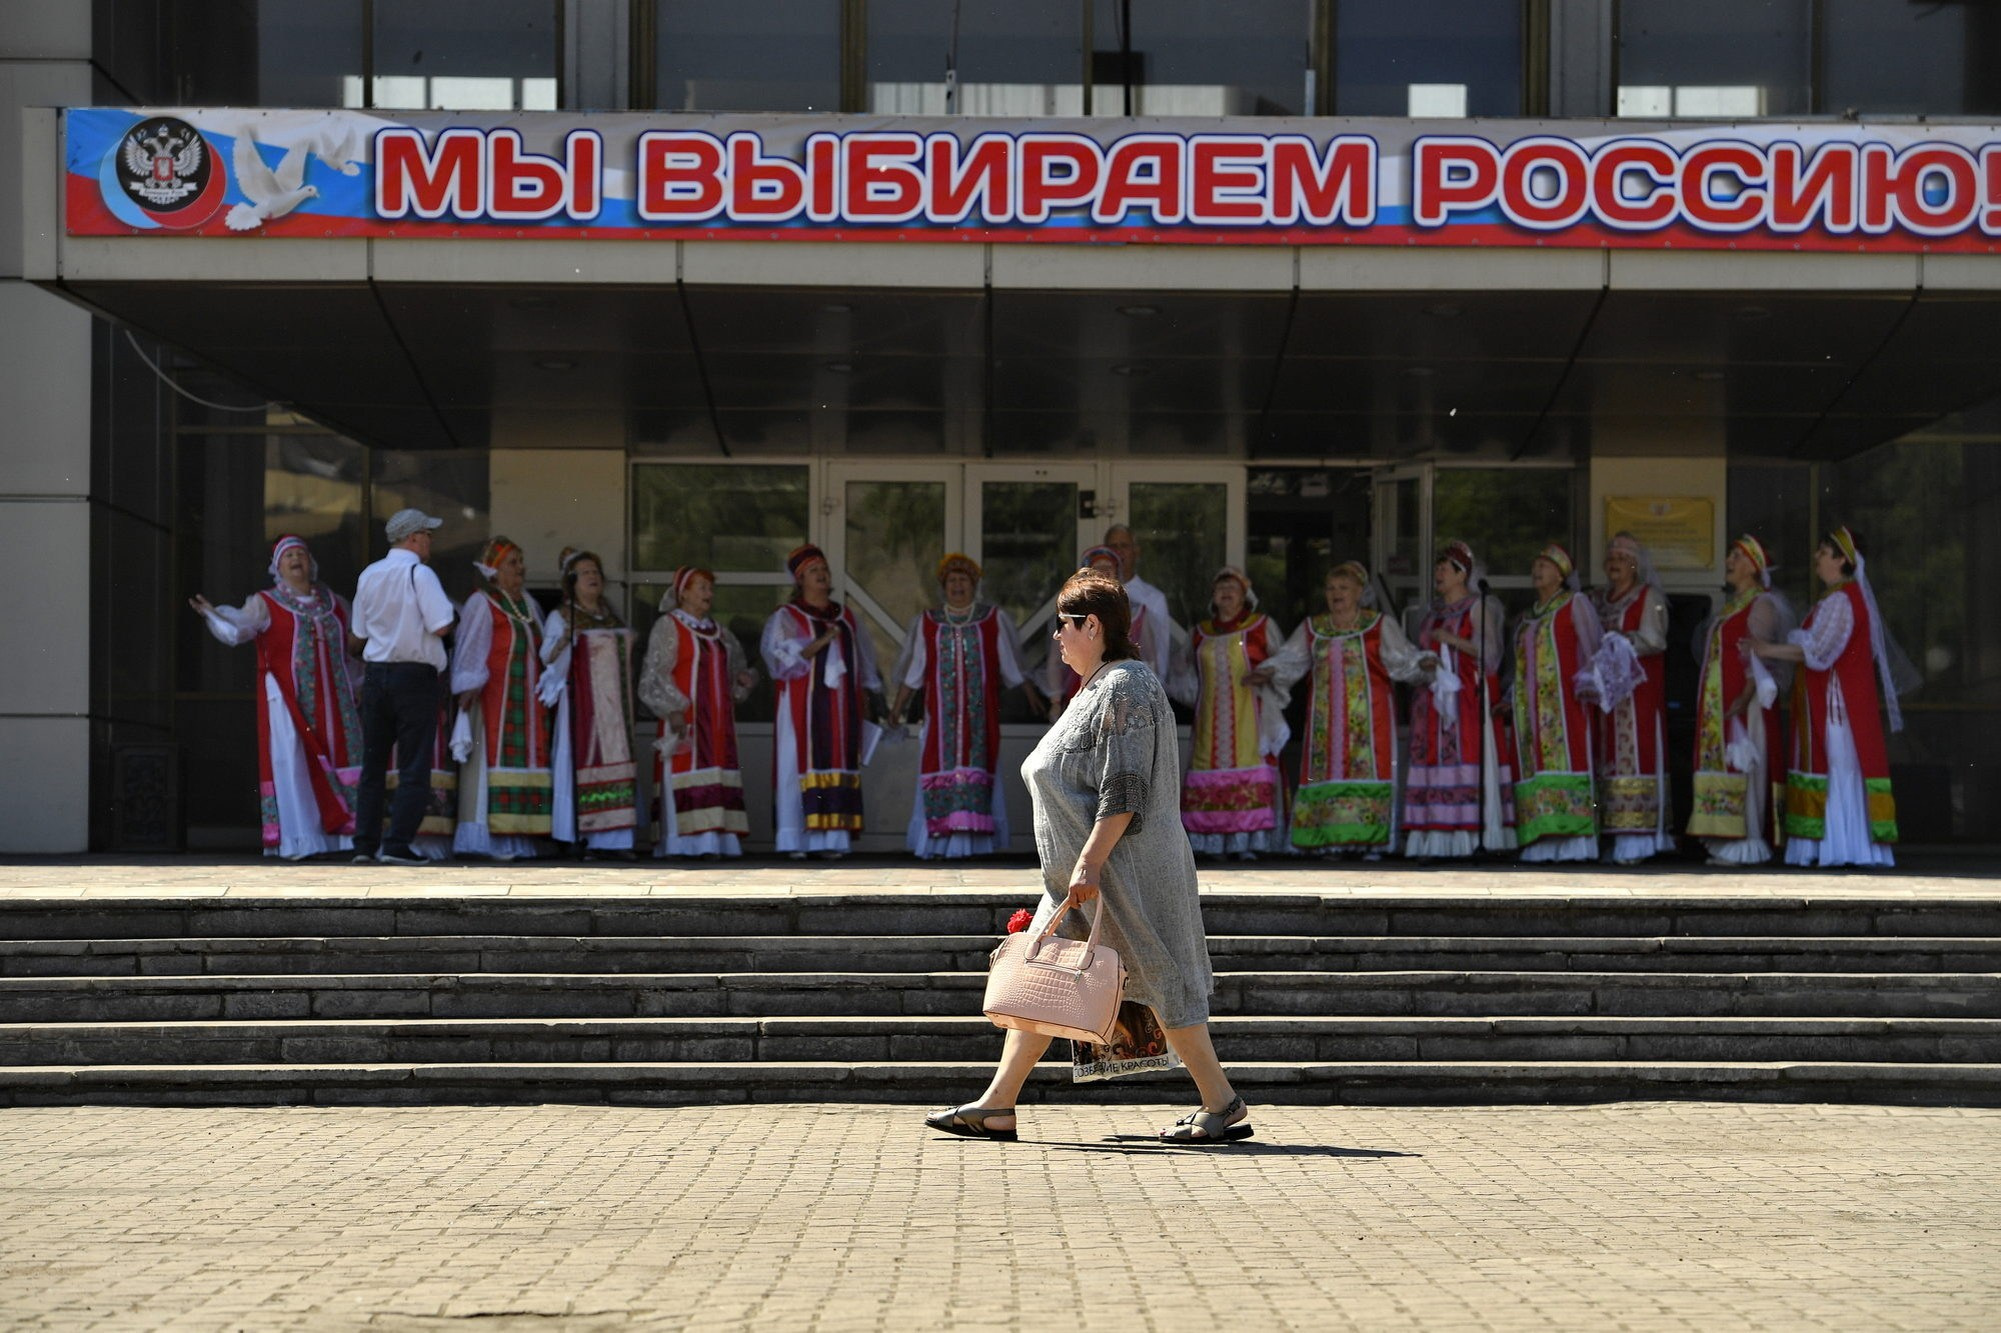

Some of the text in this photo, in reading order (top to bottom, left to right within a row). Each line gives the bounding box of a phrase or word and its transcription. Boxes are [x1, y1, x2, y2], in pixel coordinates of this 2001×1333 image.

[373, 127, 2001, 238] МЫ ВЫБИРАЕМ РОССИЮ!
[1121, 1056, 1169, 1070] КРАСОТЫ
